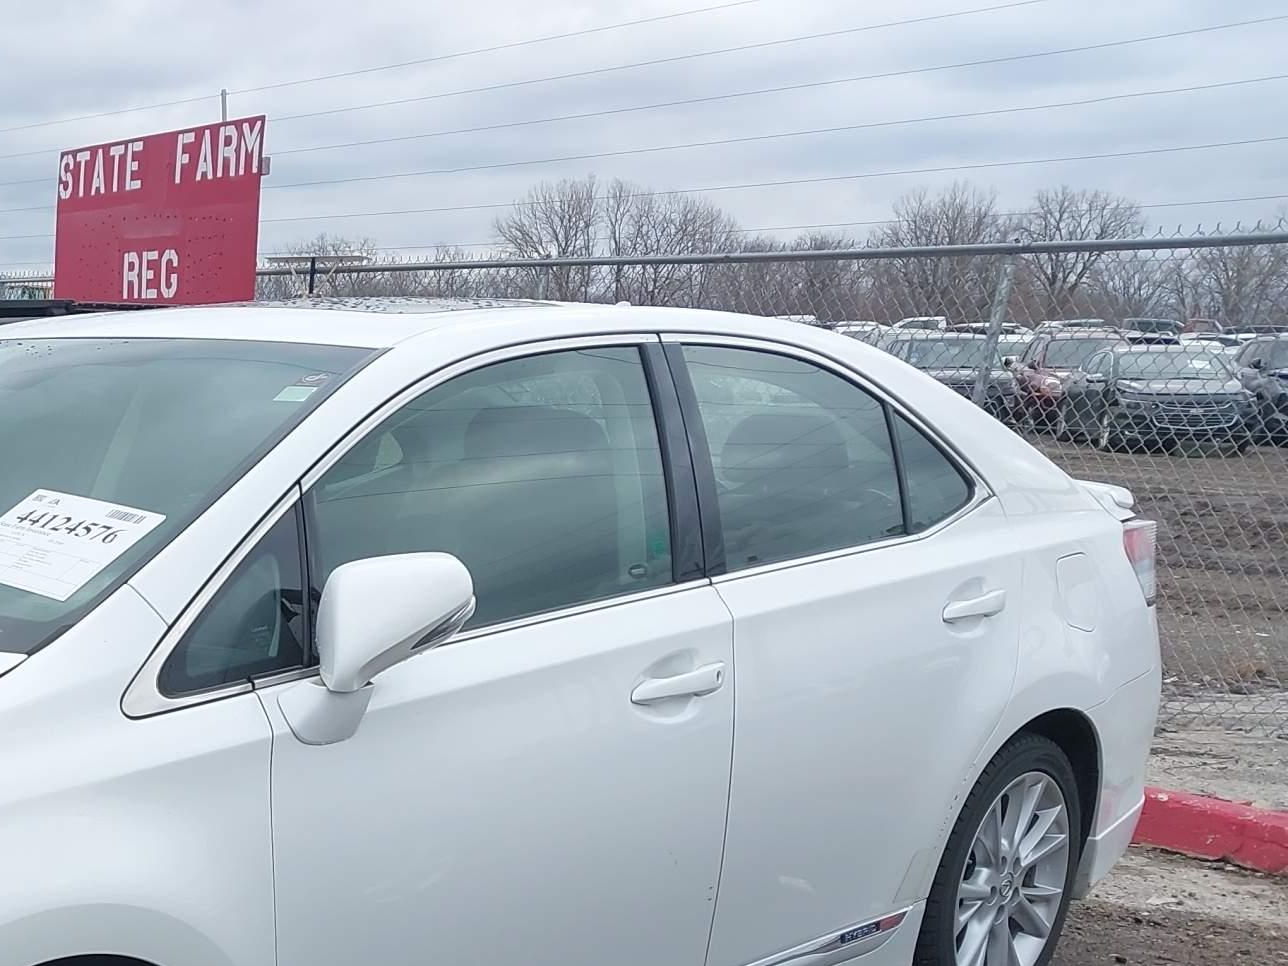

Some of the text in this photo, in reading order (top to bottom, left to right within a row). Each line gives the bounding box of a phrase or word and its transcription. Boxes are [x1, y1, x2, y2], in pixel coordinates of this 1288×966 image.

[58, 120, 262, 200] STATE FARM
[122, 249, 179, 299] REG
[15, 509, 128, 545] 44124576
